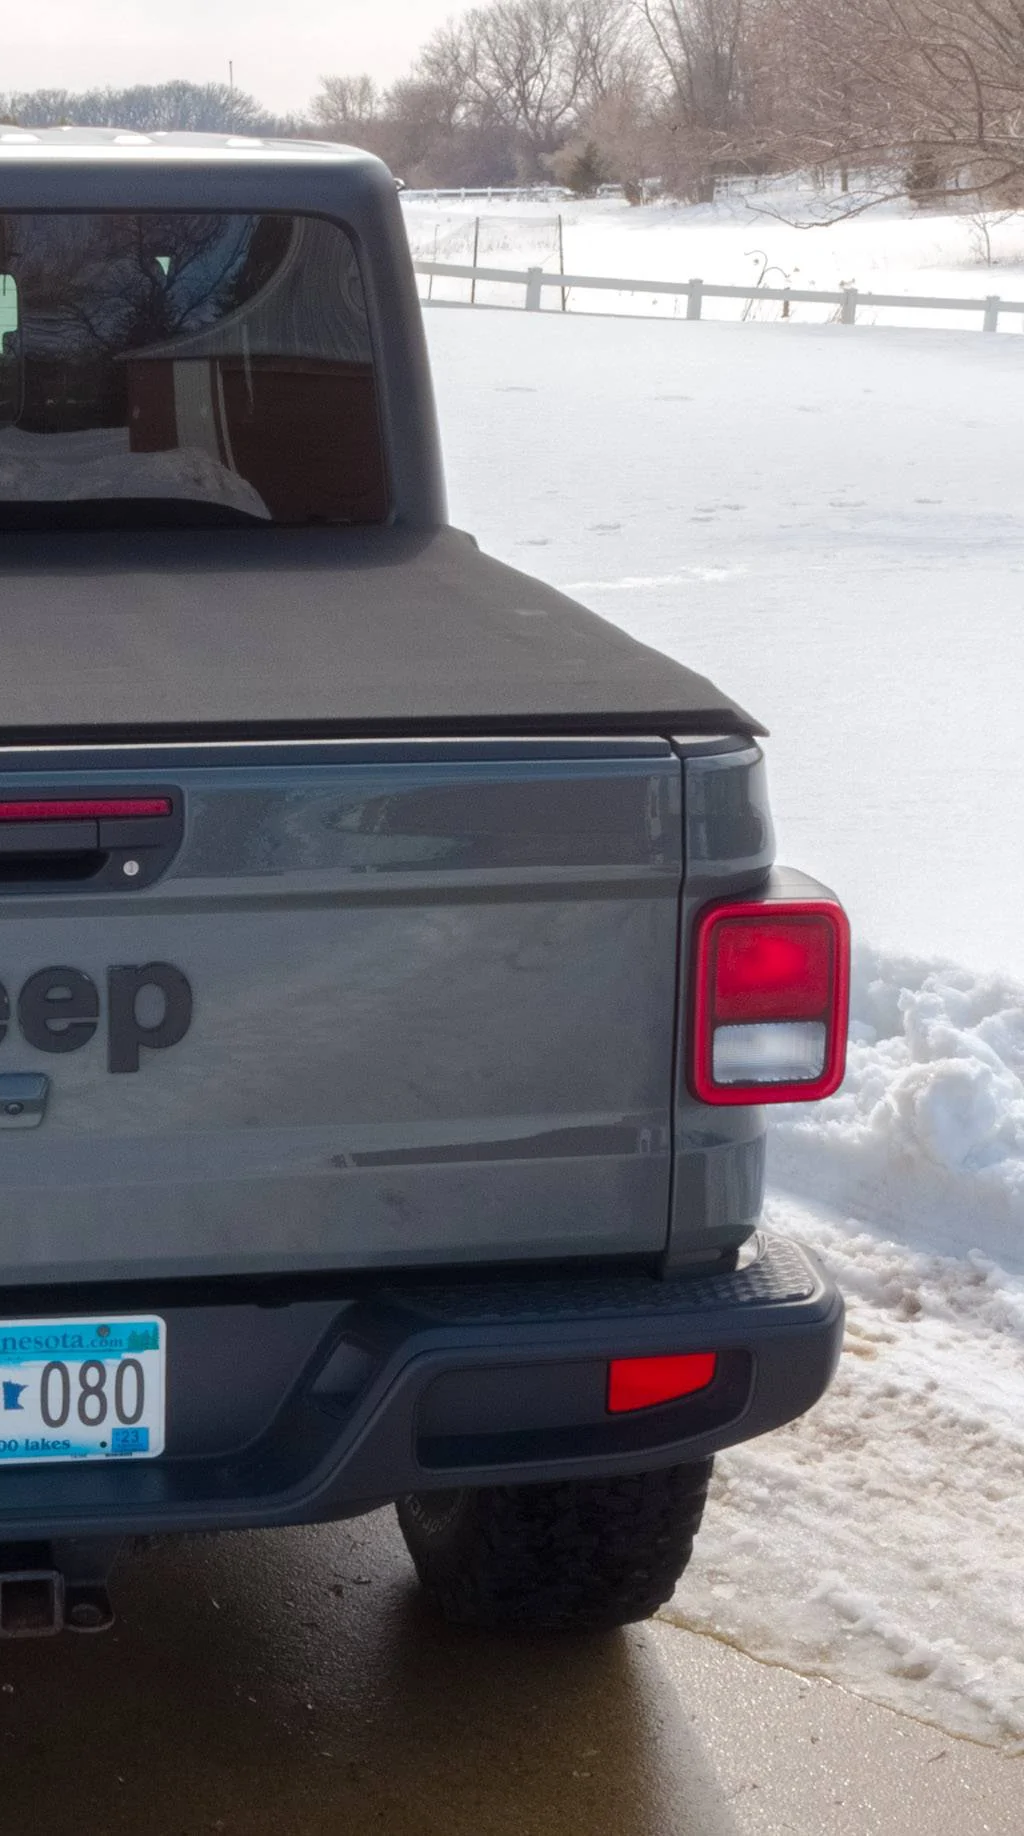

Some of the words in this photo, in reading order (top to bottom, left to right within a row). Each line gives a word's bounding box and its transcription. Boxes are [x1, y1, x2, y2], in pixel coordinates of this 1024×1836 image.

[40, 1358, 145, 1428] 080
[120, 1429, 140, 1443] 23
[25, 1437, 71, 1451] lakes
